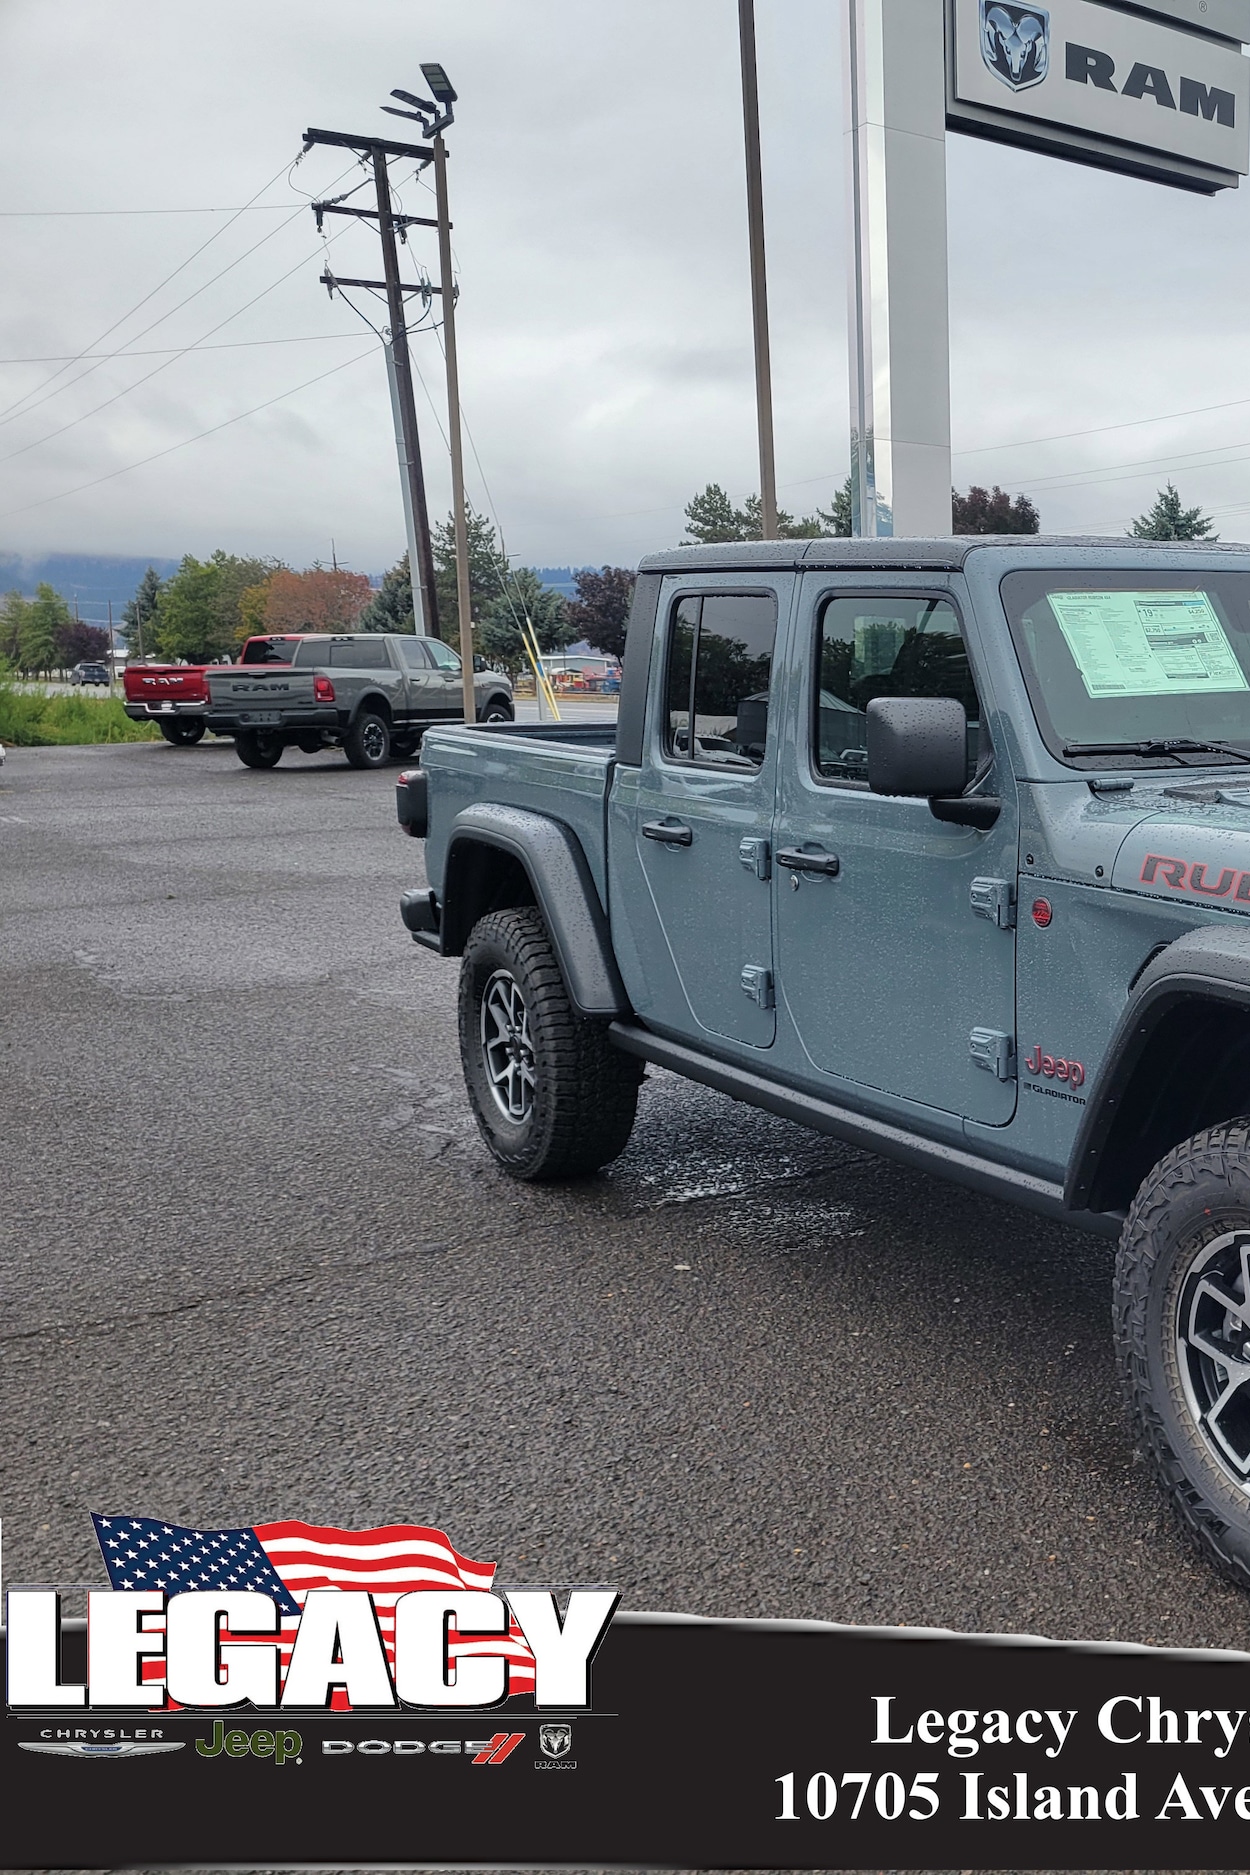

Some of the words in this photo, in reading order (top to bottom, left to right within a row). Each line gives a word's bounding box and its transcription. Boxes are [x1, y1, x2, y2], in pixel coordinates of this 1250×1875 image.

[1065, 41, 1235, 129] RAM
[1143, 609, 1153, 617] 19
[142, 677, 184, 686] RAM
[232, 683, 290, 692] RAM
[1024, 1045, 1085, 1091] Jeep
[1032, 1084, 1086, 1106] GLADIATOR
